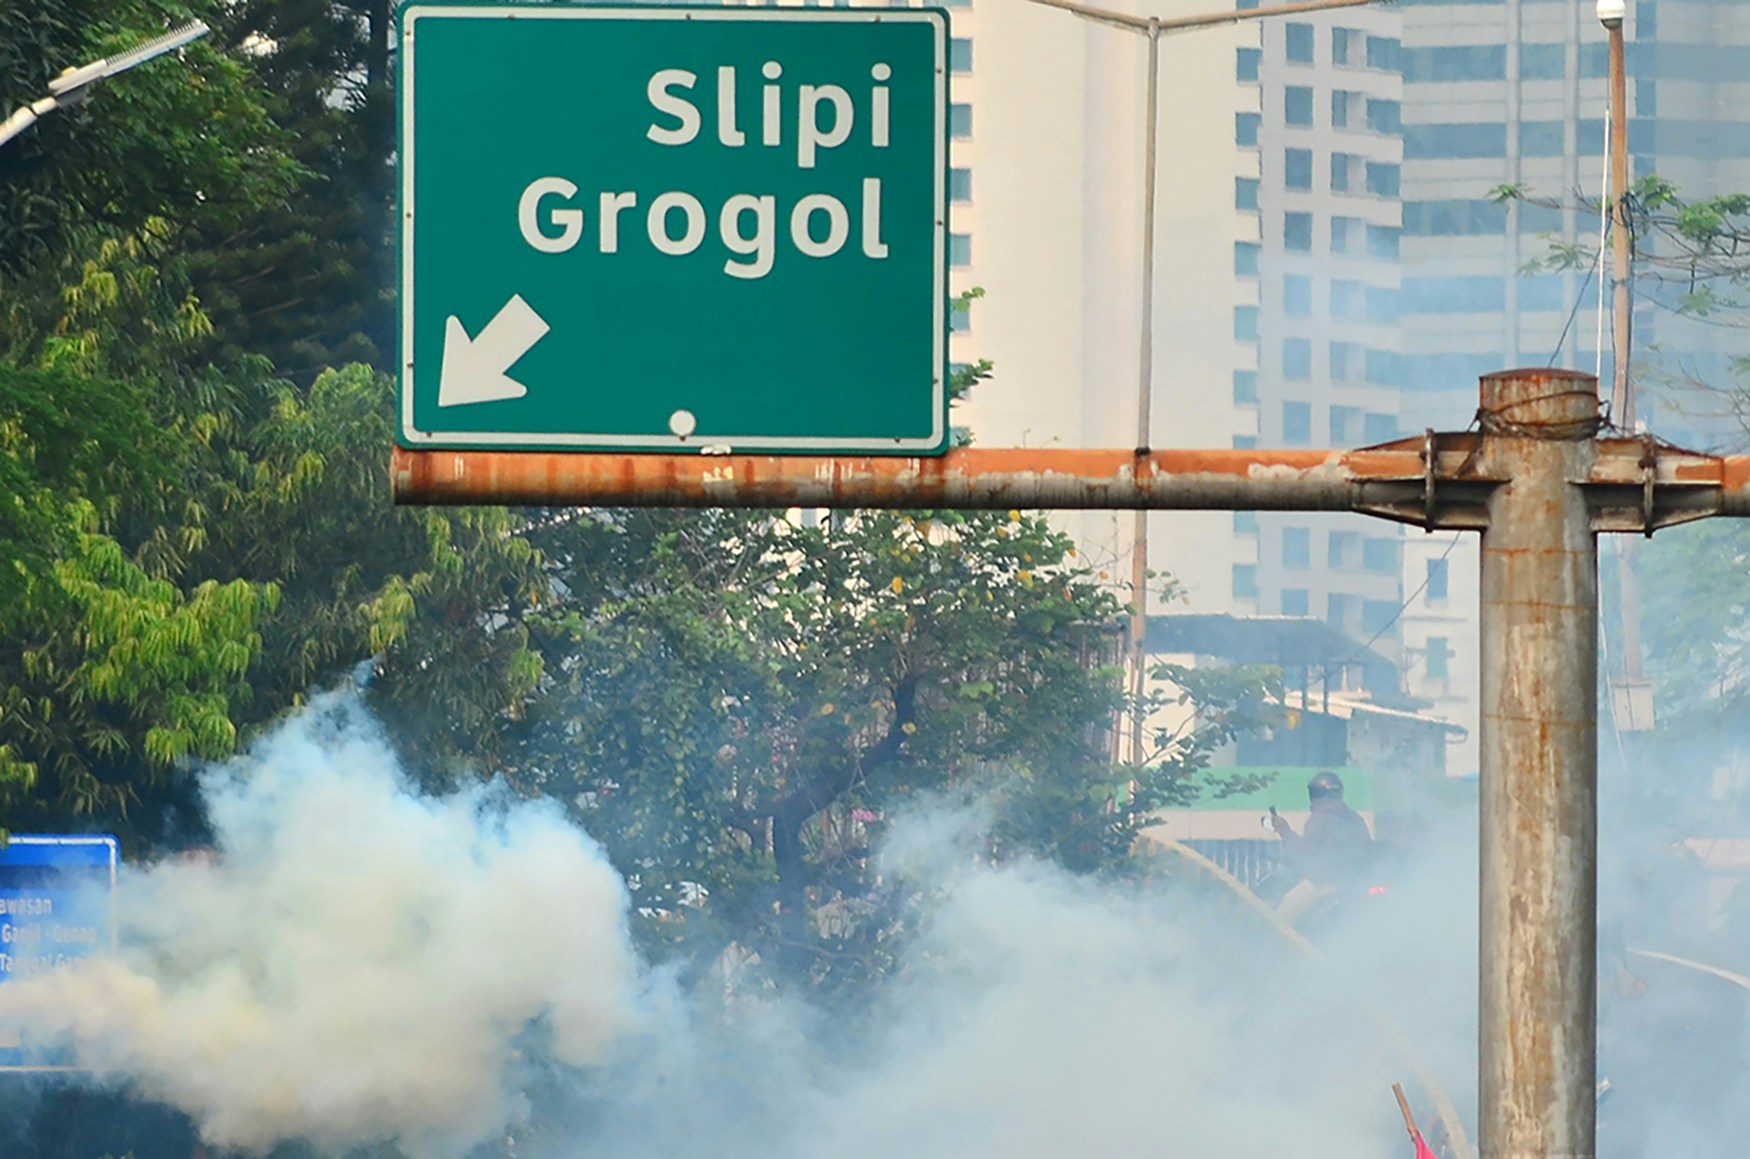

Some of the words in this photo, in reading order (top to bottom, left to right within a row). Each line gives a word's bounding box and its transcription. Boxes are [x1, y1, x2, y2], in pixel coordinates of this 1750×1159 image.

[645, 60, 893, 169] Slipi
[518, 175, 890, 279] Grogol
[0, 897, 53, 915] awasan
